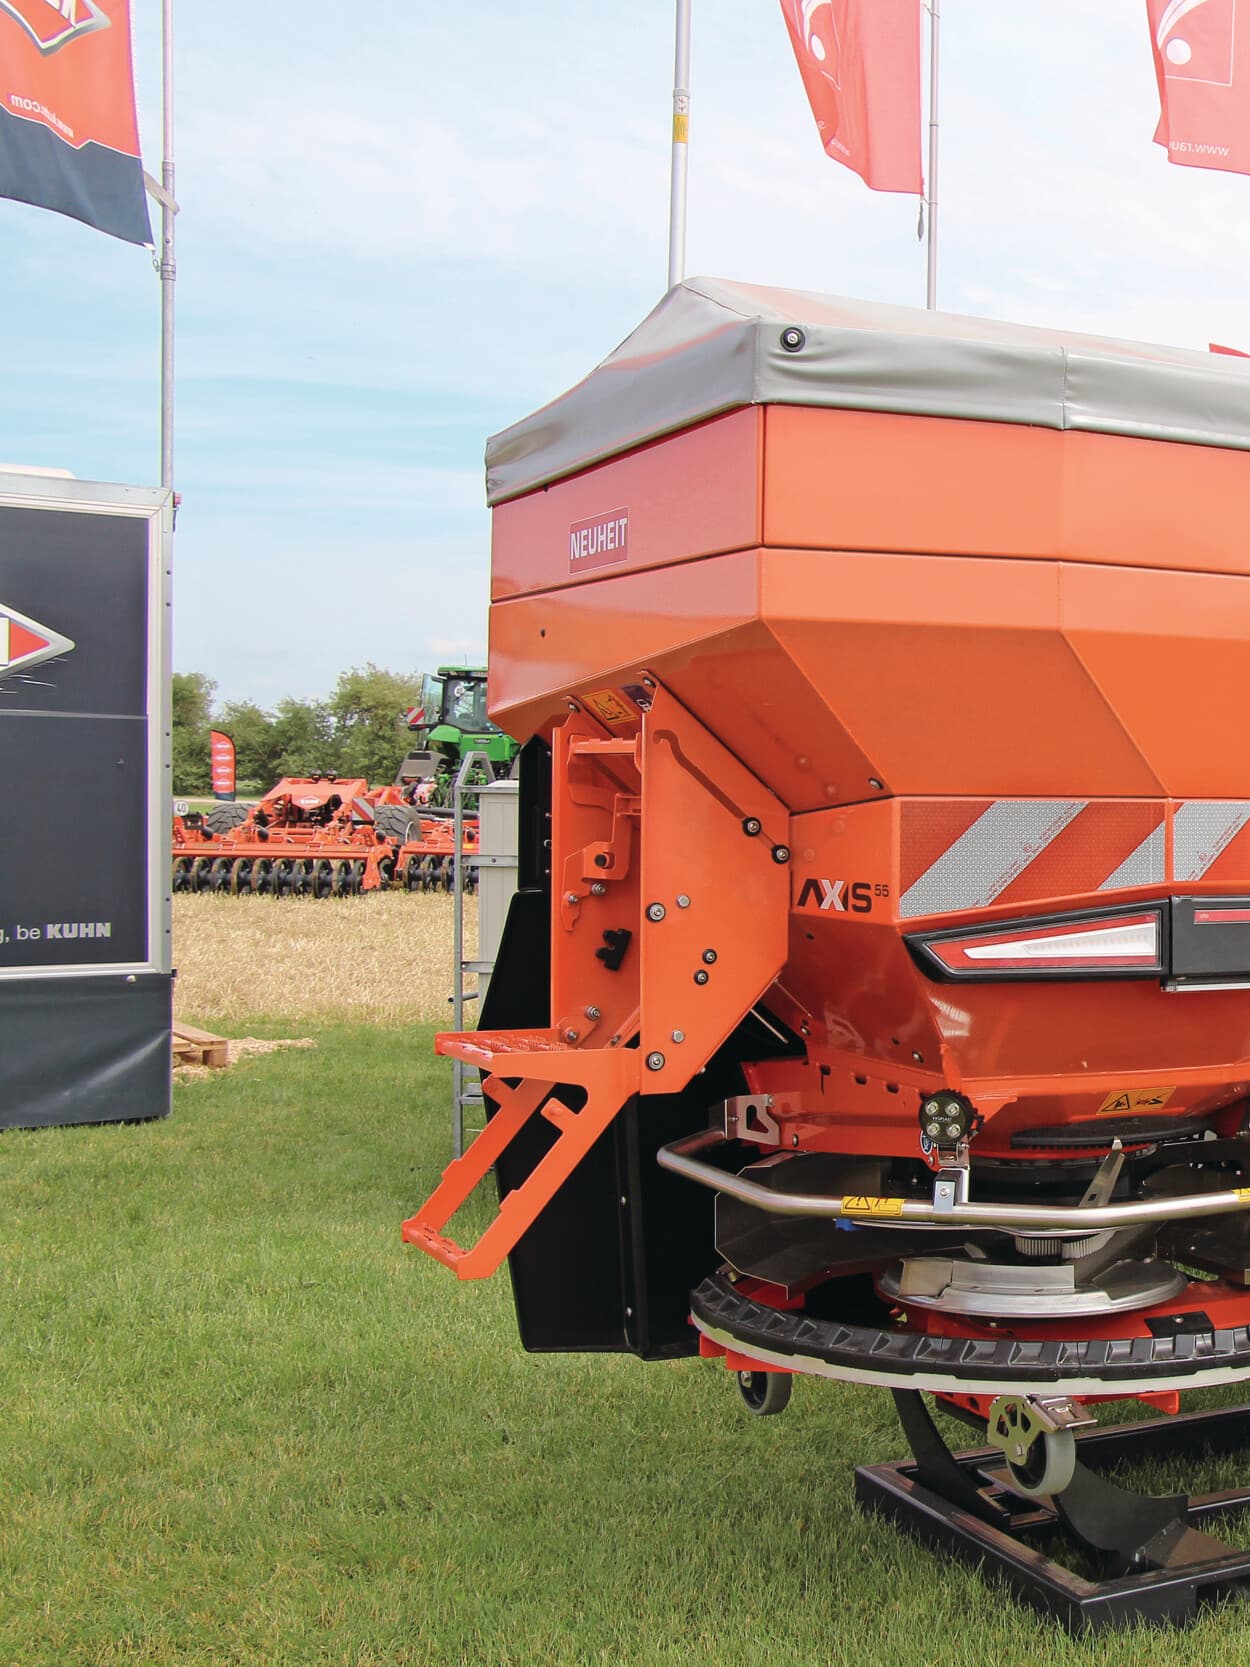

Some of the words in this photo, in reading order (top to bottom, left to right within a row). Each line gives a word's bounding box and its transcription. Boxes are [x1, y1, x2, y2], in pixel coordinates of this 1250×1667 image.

[570, 517, 628, 560] NEUHEIT
[797, 878, 873, 913] AXIS
[16, 925, 41, 940] be
[47, 922, 111, 939] KUHN
